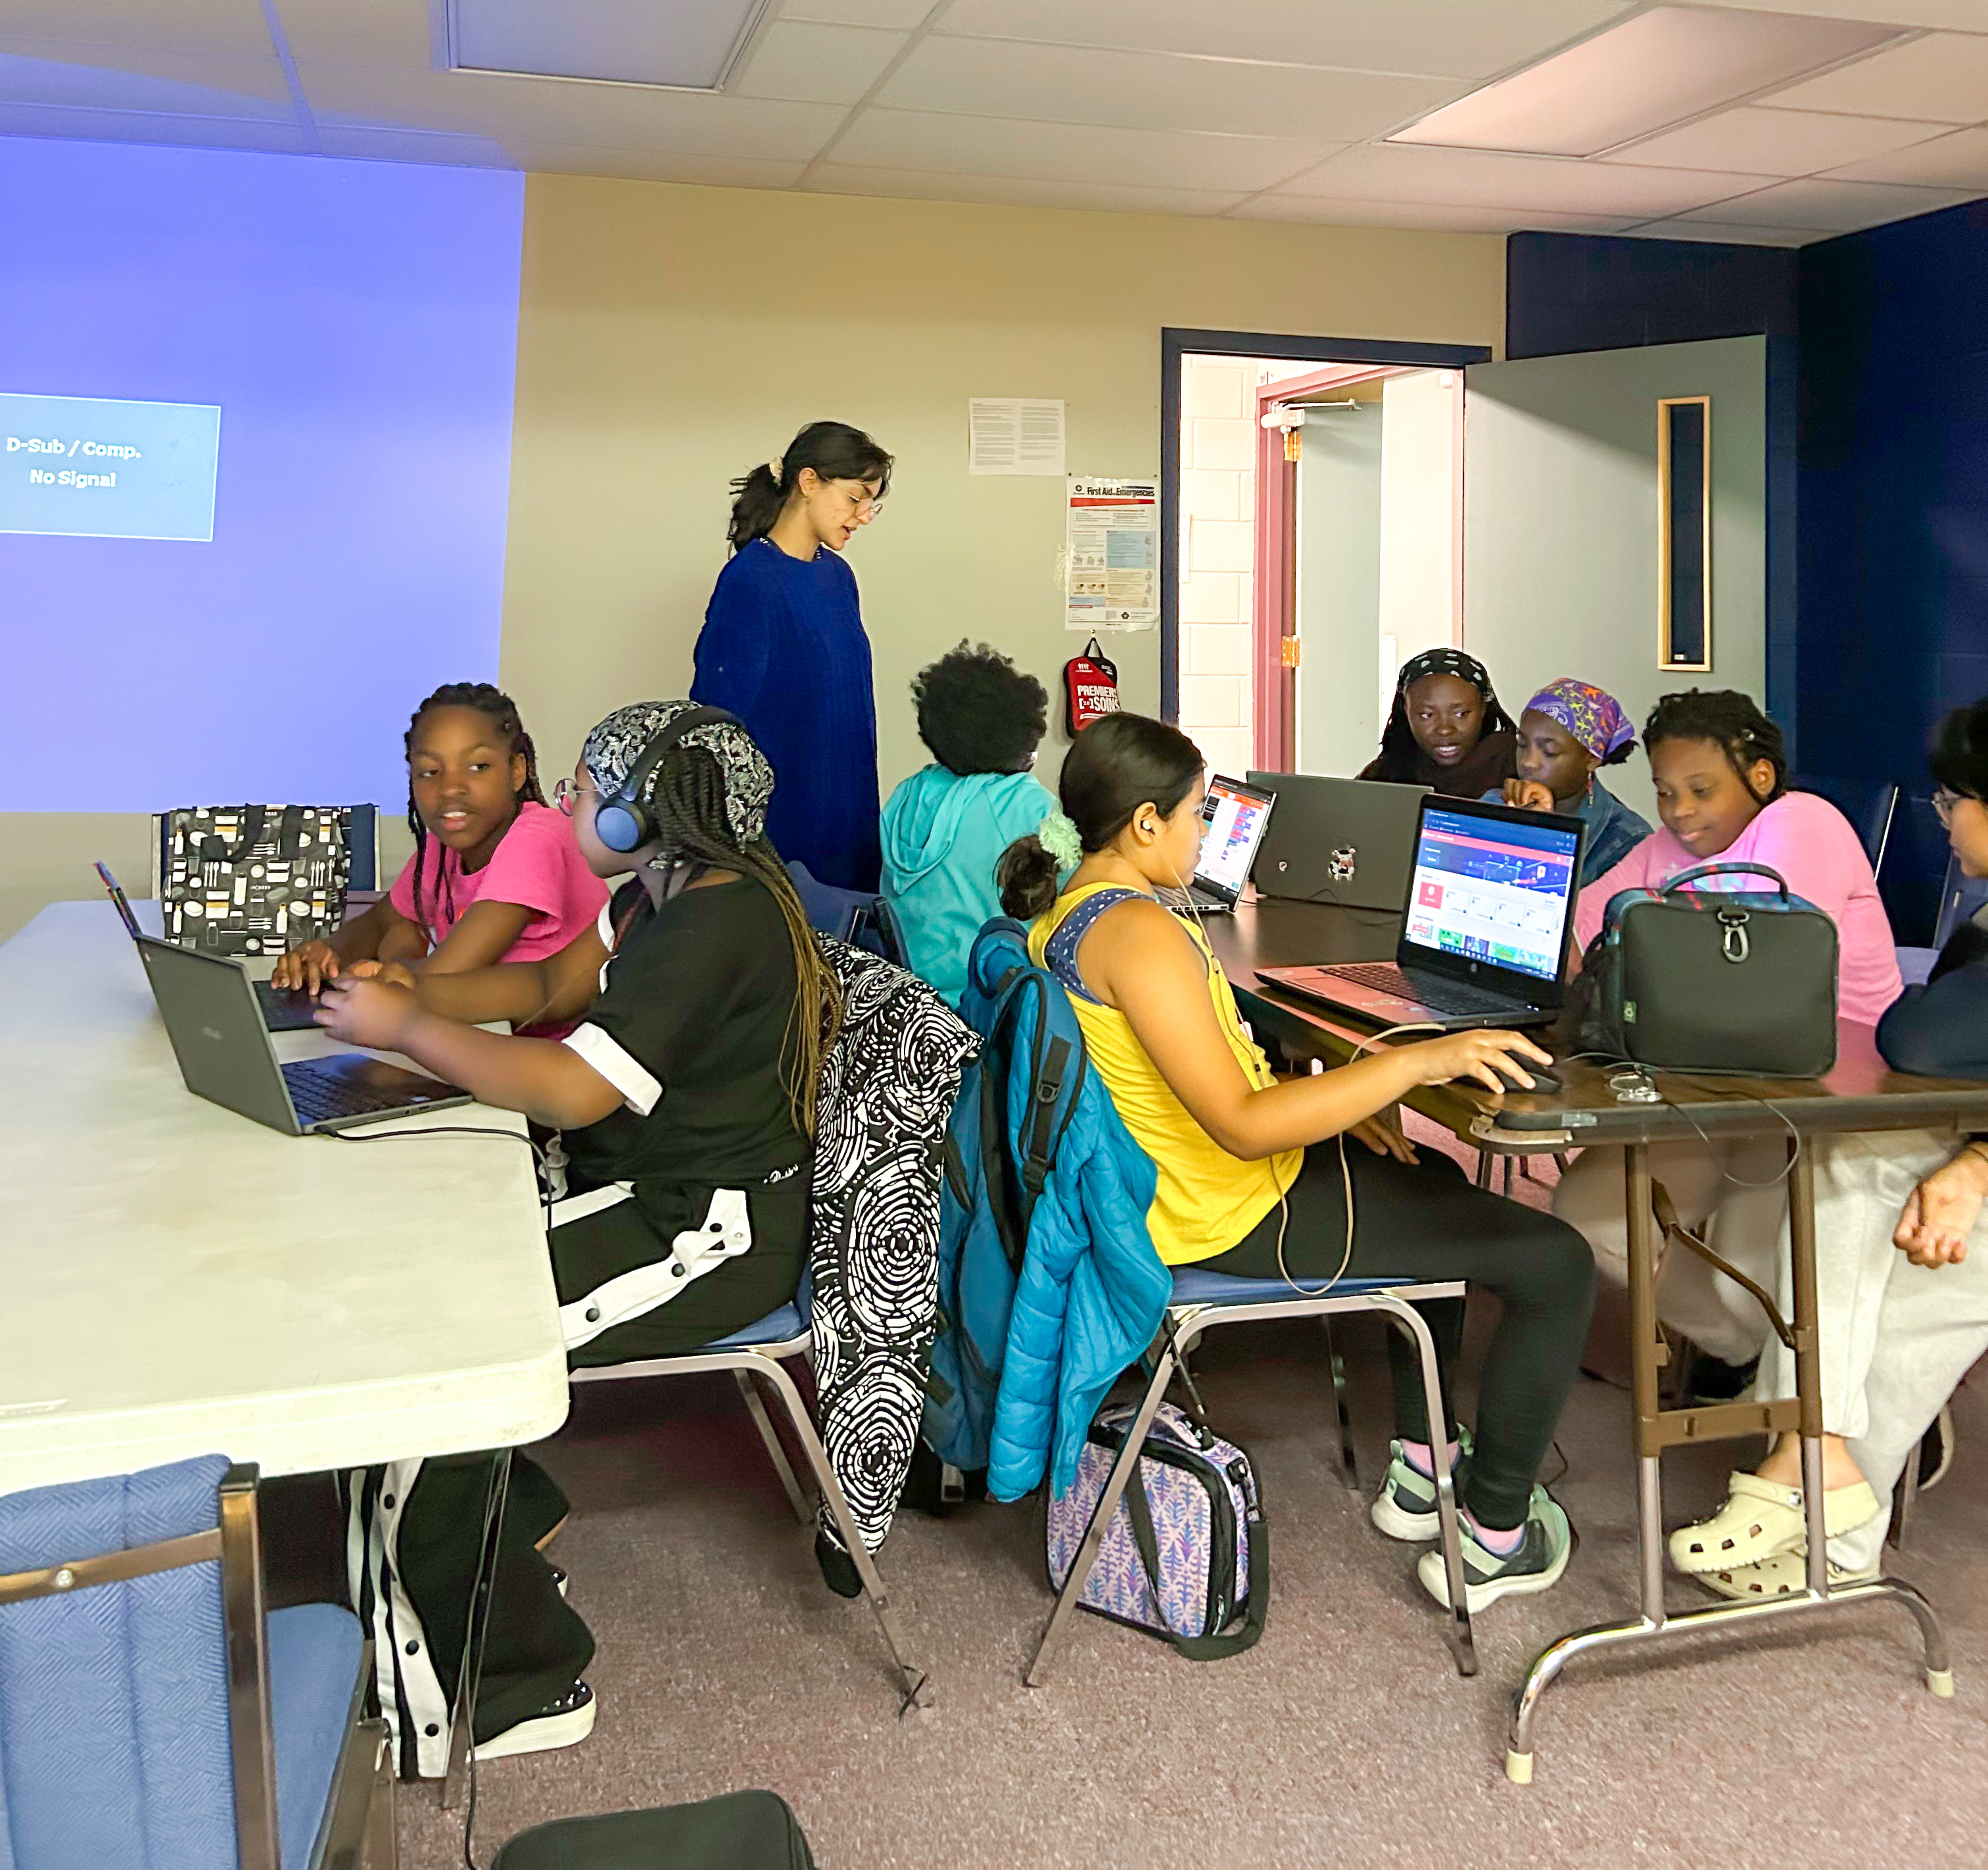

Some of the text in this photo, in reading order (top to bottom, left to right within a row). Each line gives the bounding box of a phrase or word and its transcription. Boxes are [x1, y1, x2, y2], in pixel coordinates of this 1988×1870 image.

[7, 437, 141, 459] D-Sub / Comp.
[30, 469, 116, 488] No Signal
